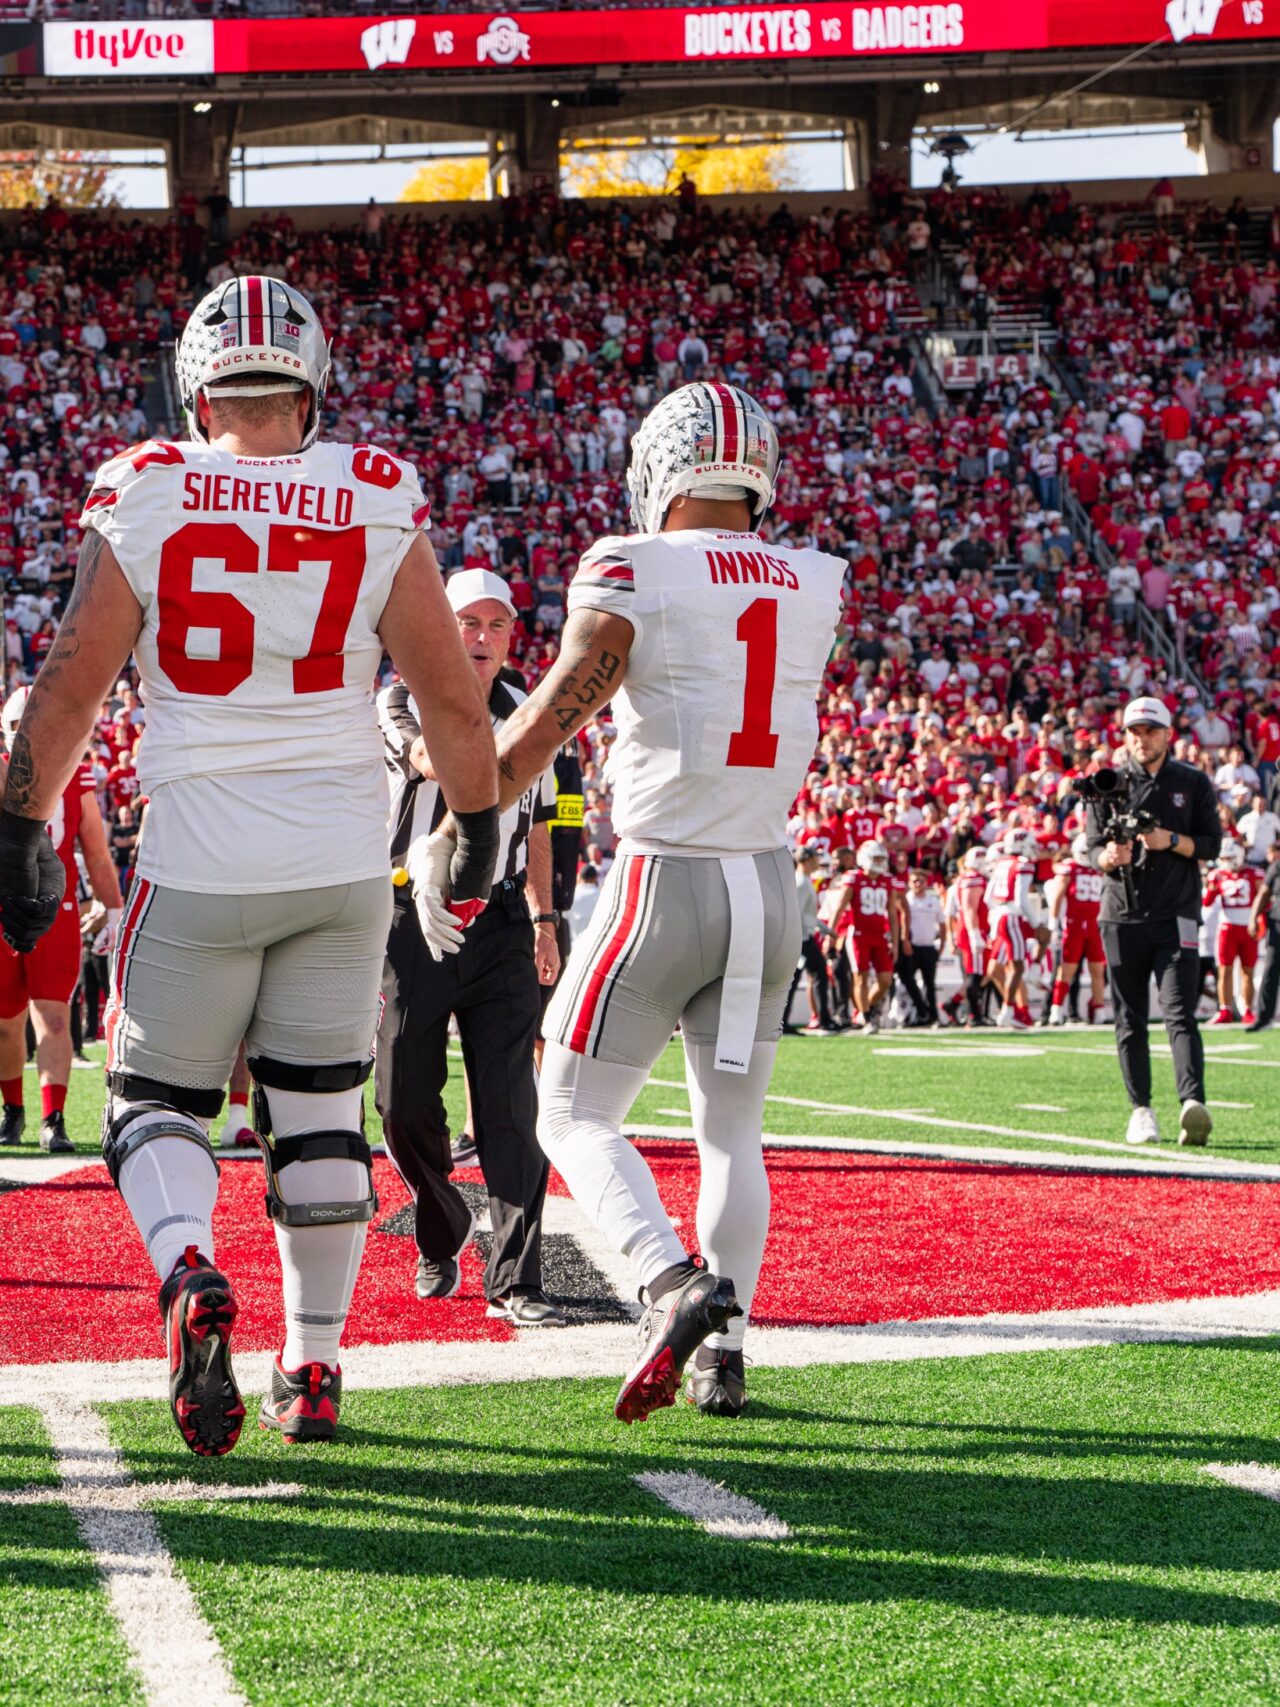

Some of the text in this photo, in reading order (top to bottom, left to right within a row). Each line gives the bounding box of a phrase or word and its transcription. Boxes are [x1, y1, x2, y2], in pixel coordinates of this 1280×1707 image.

[1242, 1, 1264, 25] VS
[684, 3, 964, 56] BUCKEYES VS BADGERS
[433, 31, 454, 54] VS
[223, 337, 236, 348] 67
[212, 352, 301, 371] BUCKEYES
[953, 357, 967, 376] F
[236, 458, 302, 466] BUCKEYES
[695, 464, 761, 479] BUCKEYES
[182, 472, 354, 527] SIEREVELD
[705, 551, 799, 590] INNISS
[157, 522, 367, 697] 67
[726, 597, 780, 768] 1
[561, 806, 579, 815] CBS
[856, 819, 873, 836] 13
[860, 887, 888, 915] 90
[1220, 880, 1251, 906] 23
[310, 1208, 360, 1218] DONJOY
